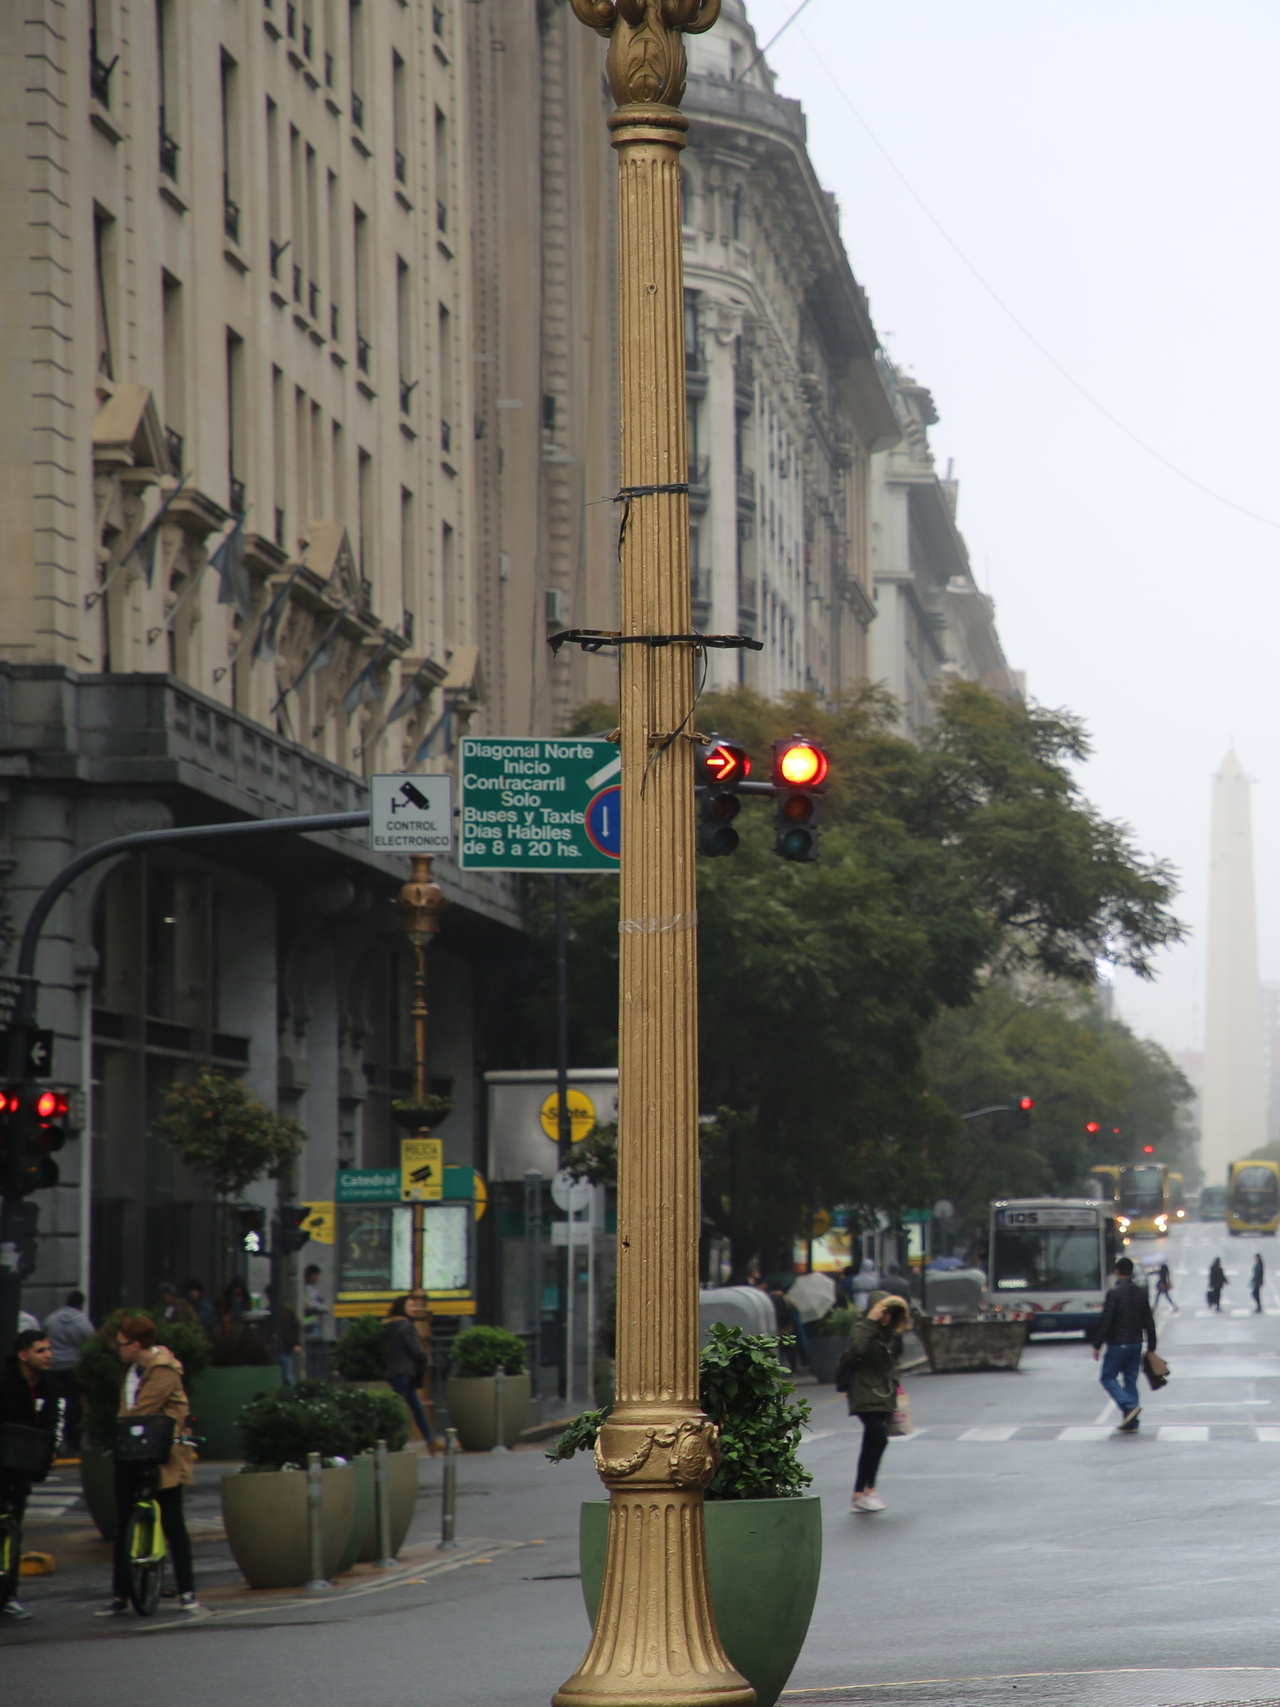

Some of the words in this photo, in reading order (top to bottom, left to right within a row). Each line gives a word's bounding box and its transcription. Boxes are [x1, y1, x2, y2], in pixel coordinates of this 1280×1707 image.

[464, 742, 540, 760] Diagonal
[545, 743, 594, 759] Norte
[504, 759, 551, 775] Inicio
[463, 773, 566, 791] Contracarril
[501, 791, 541, 807] Solo
[464, 807, 518, 823] Buses
[524, 811, 535, 826] y
[539, 808, 585, 824] Taxis
[386, 821, 438, 831] CONTROL
[374, 835, 450, 846] ELECTRONICO
[463, 839, 486, 855] de
[492, 840, 505, 855] 8
[510, 843, 522, 856] a
[528, 841, 552, 856] 20
[557, 842, 582, 857] hs.
[341, 1173, 397, 1187] Catedral
[1009, 1212, 1038, 1224] 105
